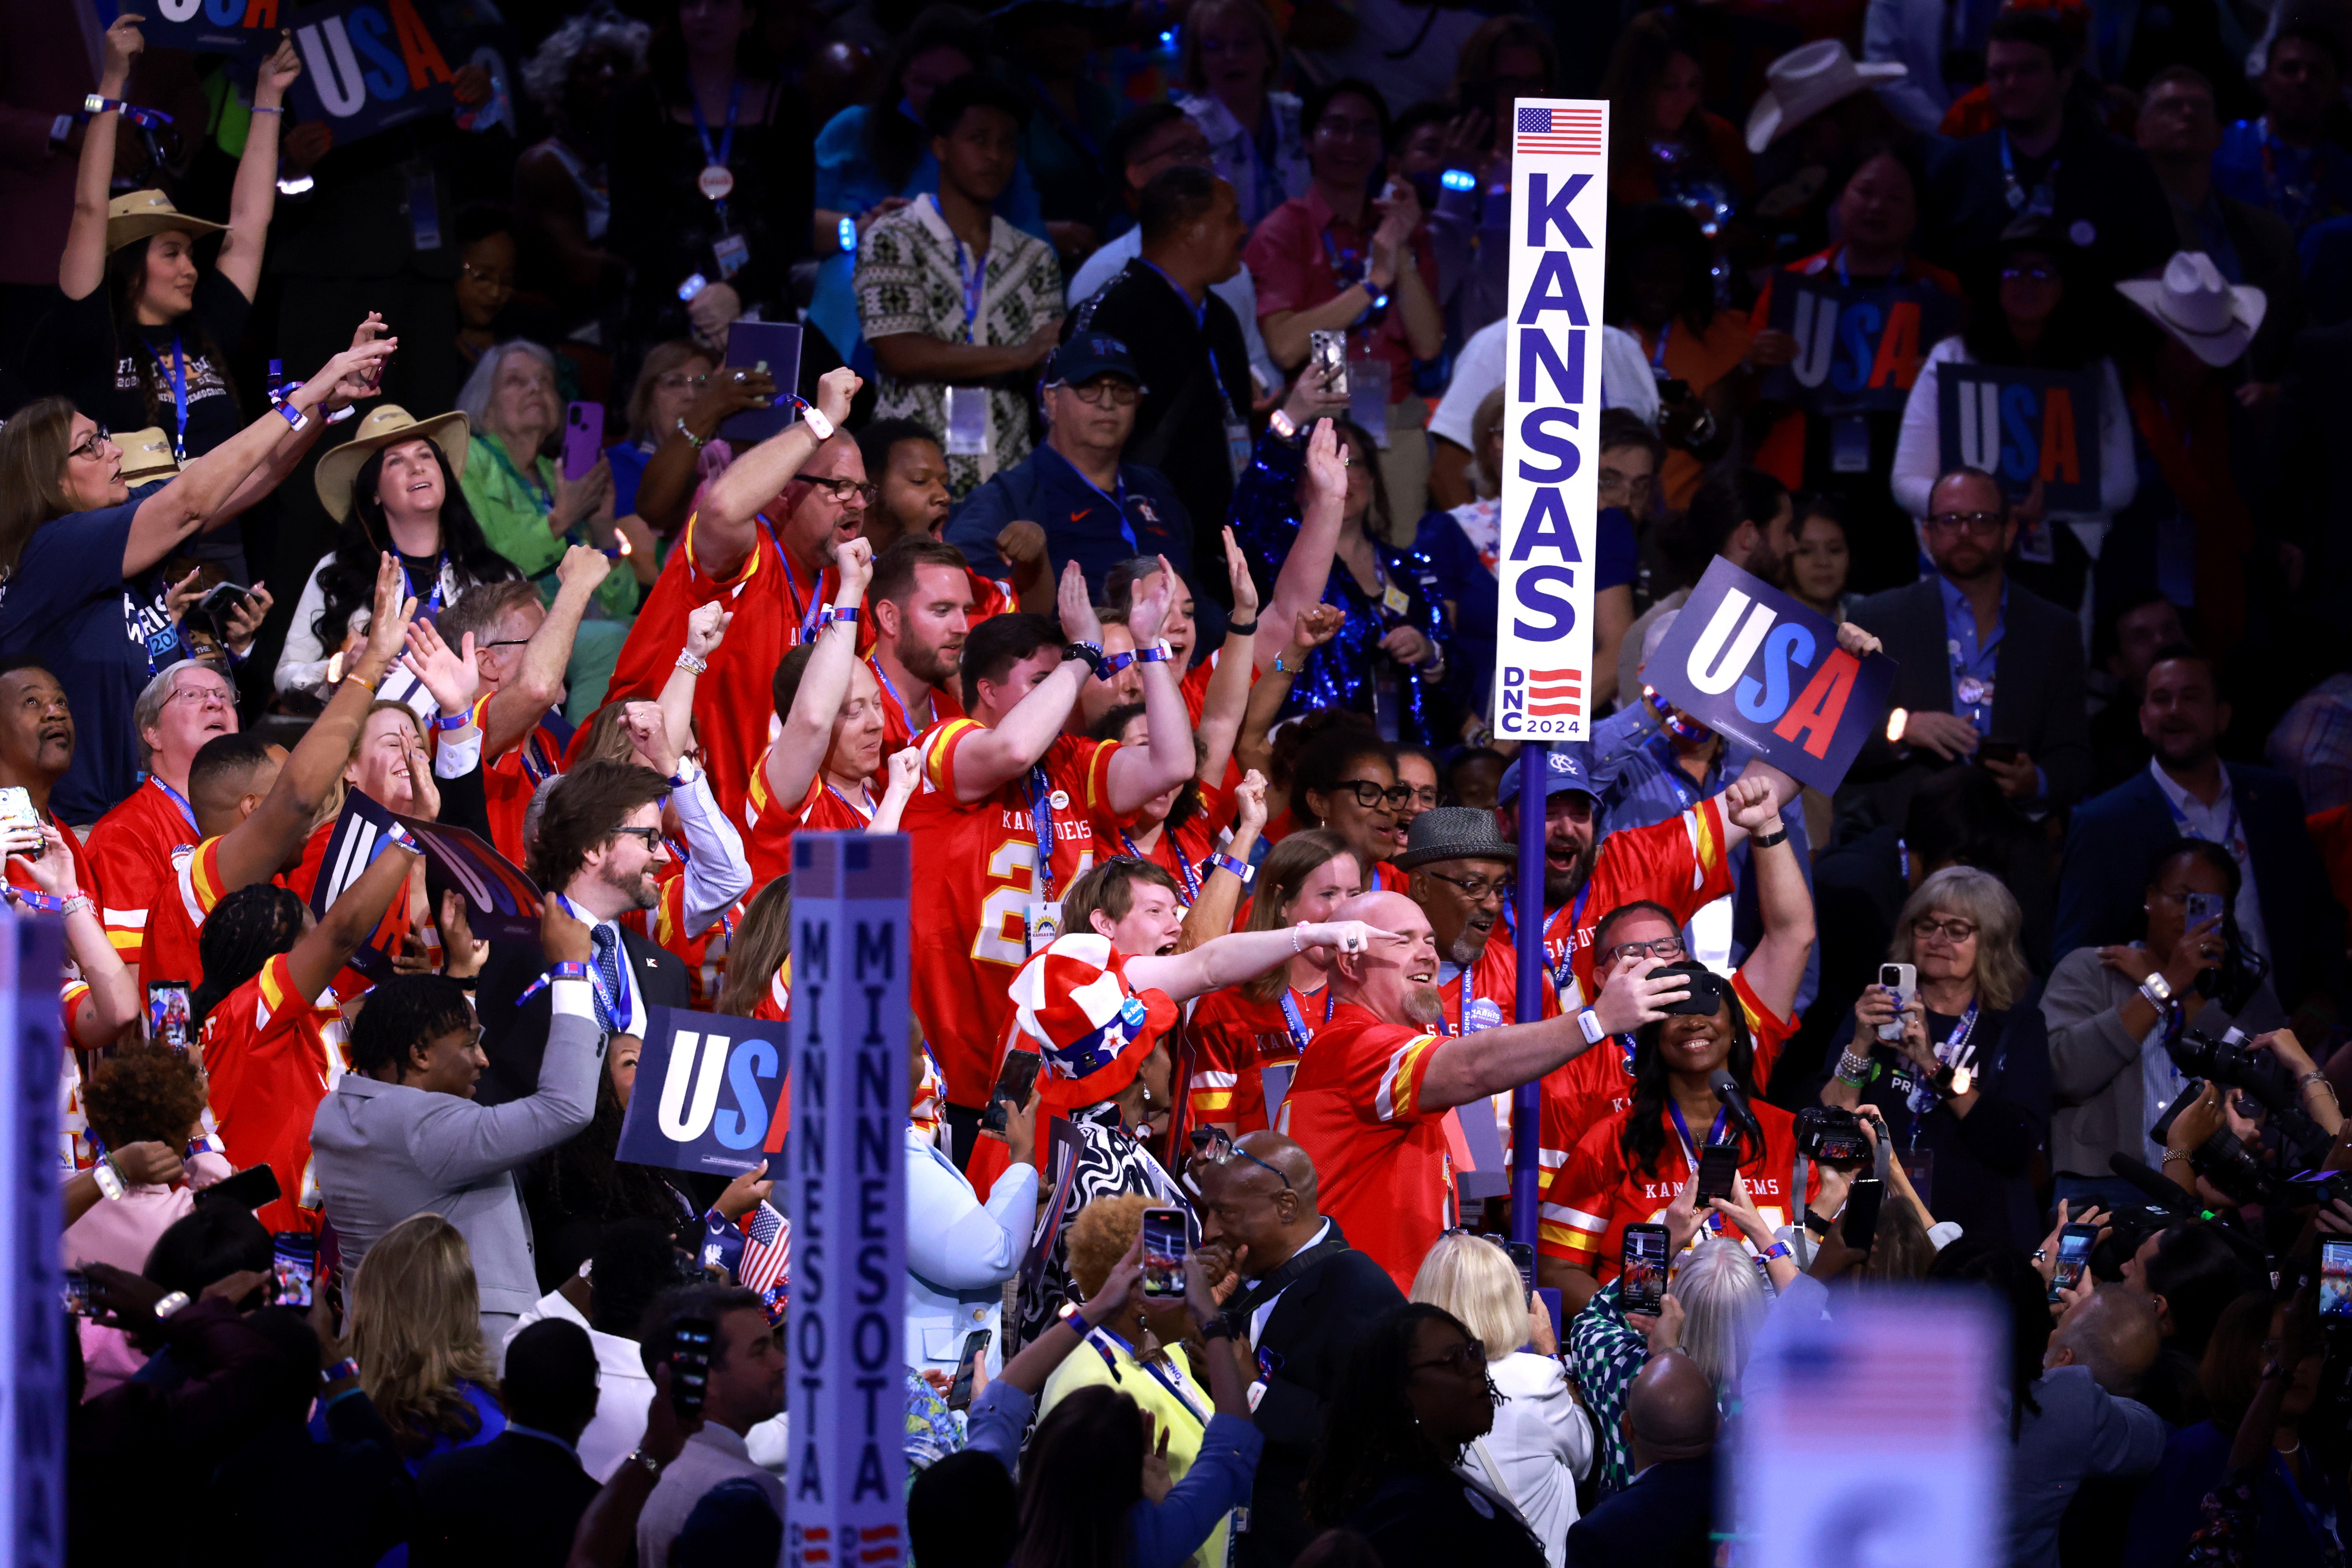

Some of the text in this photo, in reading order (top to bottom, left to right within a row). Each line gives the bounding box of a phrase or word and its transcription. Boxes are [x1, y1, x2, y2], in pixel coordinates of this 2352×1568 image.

[297, 0, 454, 118] USA
[1791, 290, 1921, 392] USA
[1509, 173, 1594, 642] KANSAS
[1958, 379, 2080, 484] USA
[151, 627, 178, 654] 202
[195, 646, 211, 654] THE
[1687, 587, 1861, 760] USA
[1502, 667, 1524, 732] DNC
[1527, 720, 1579, 733] 2024
[154, 777, 167, 791] 2024
[1002, 809, 1035, 832] KAN
[670, 844, 685, 861] DNC
[1126, 843, 1140, 858] KANS
[325, 812, 410, 956] UA
[412, 827, 541, 918] USA
[1183, 865, 1199, 899] NSAS DEMS
[1543, 926, 1597, 959] SAS DE
[1564, 936, 1573, 963] NSAS
[586, 965, 613, 1011] DNC 2024
[1123, 1011, 1132, 1020] Be
[1285, 1013, 1296, 1031] DEMS
[1471, 1008, 1500, 1020] HARRIS
[1255, 1030, 1294, 1051] KAN
[1300, 1032, 1309, 1045] DN
[1646, 1179, 1779, 1199] KAN EMS
[797, 921, 828, 1502] MINNESOTA
[852, 921, 894, 1502] MINNESOTA
